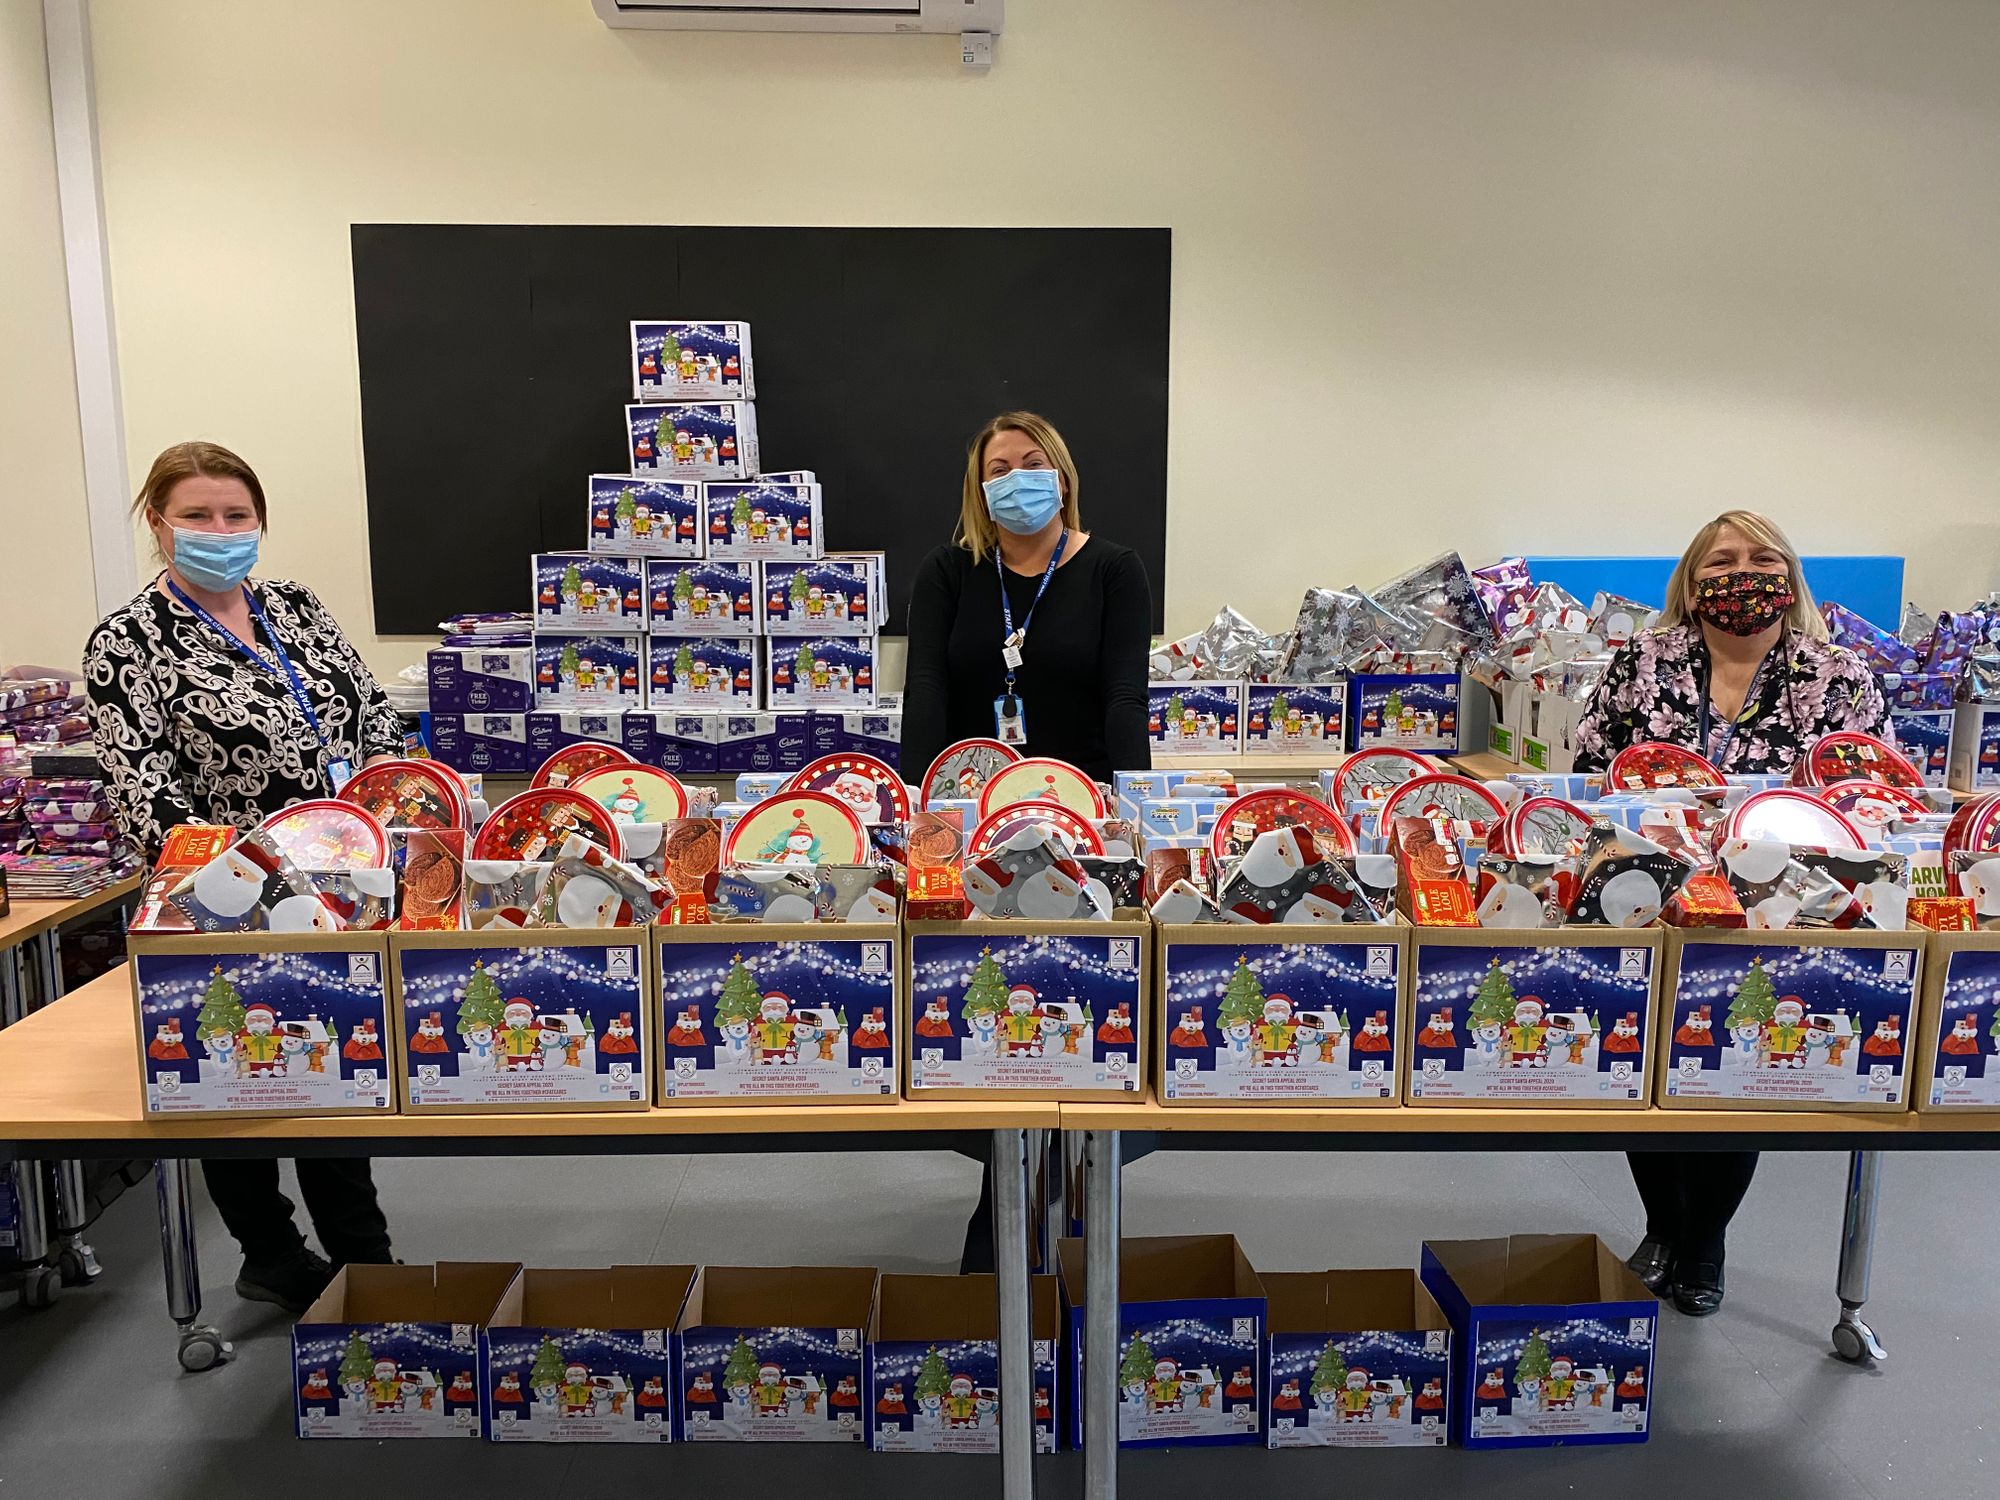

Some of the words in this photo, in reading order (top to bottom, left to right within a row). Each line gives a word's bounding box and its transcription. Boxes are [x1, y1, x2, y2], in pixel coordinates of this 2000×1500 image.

[198, 609, 243, 648] www.cfat.org.uk
[1004, 608, 1012, 630] STAFF
[434, 665, 454, 674] Cadbury
[296, 688, 314, 712] STAFF
[436, 727, 456, 736] Cadbury
[532, 727, 552, 736] Cadbury
[628, 728, 648, 737] Cadbury
[816, 727, 835, 735] Cadbury
[779, 737, 803, 748] Cadbury
[194, 836, 212, 858] YULE
[1429, 888, 1442, 913] YULE
[1440, 892, 1452, 911] LOG
[687, 904, 696, 923] ULE
